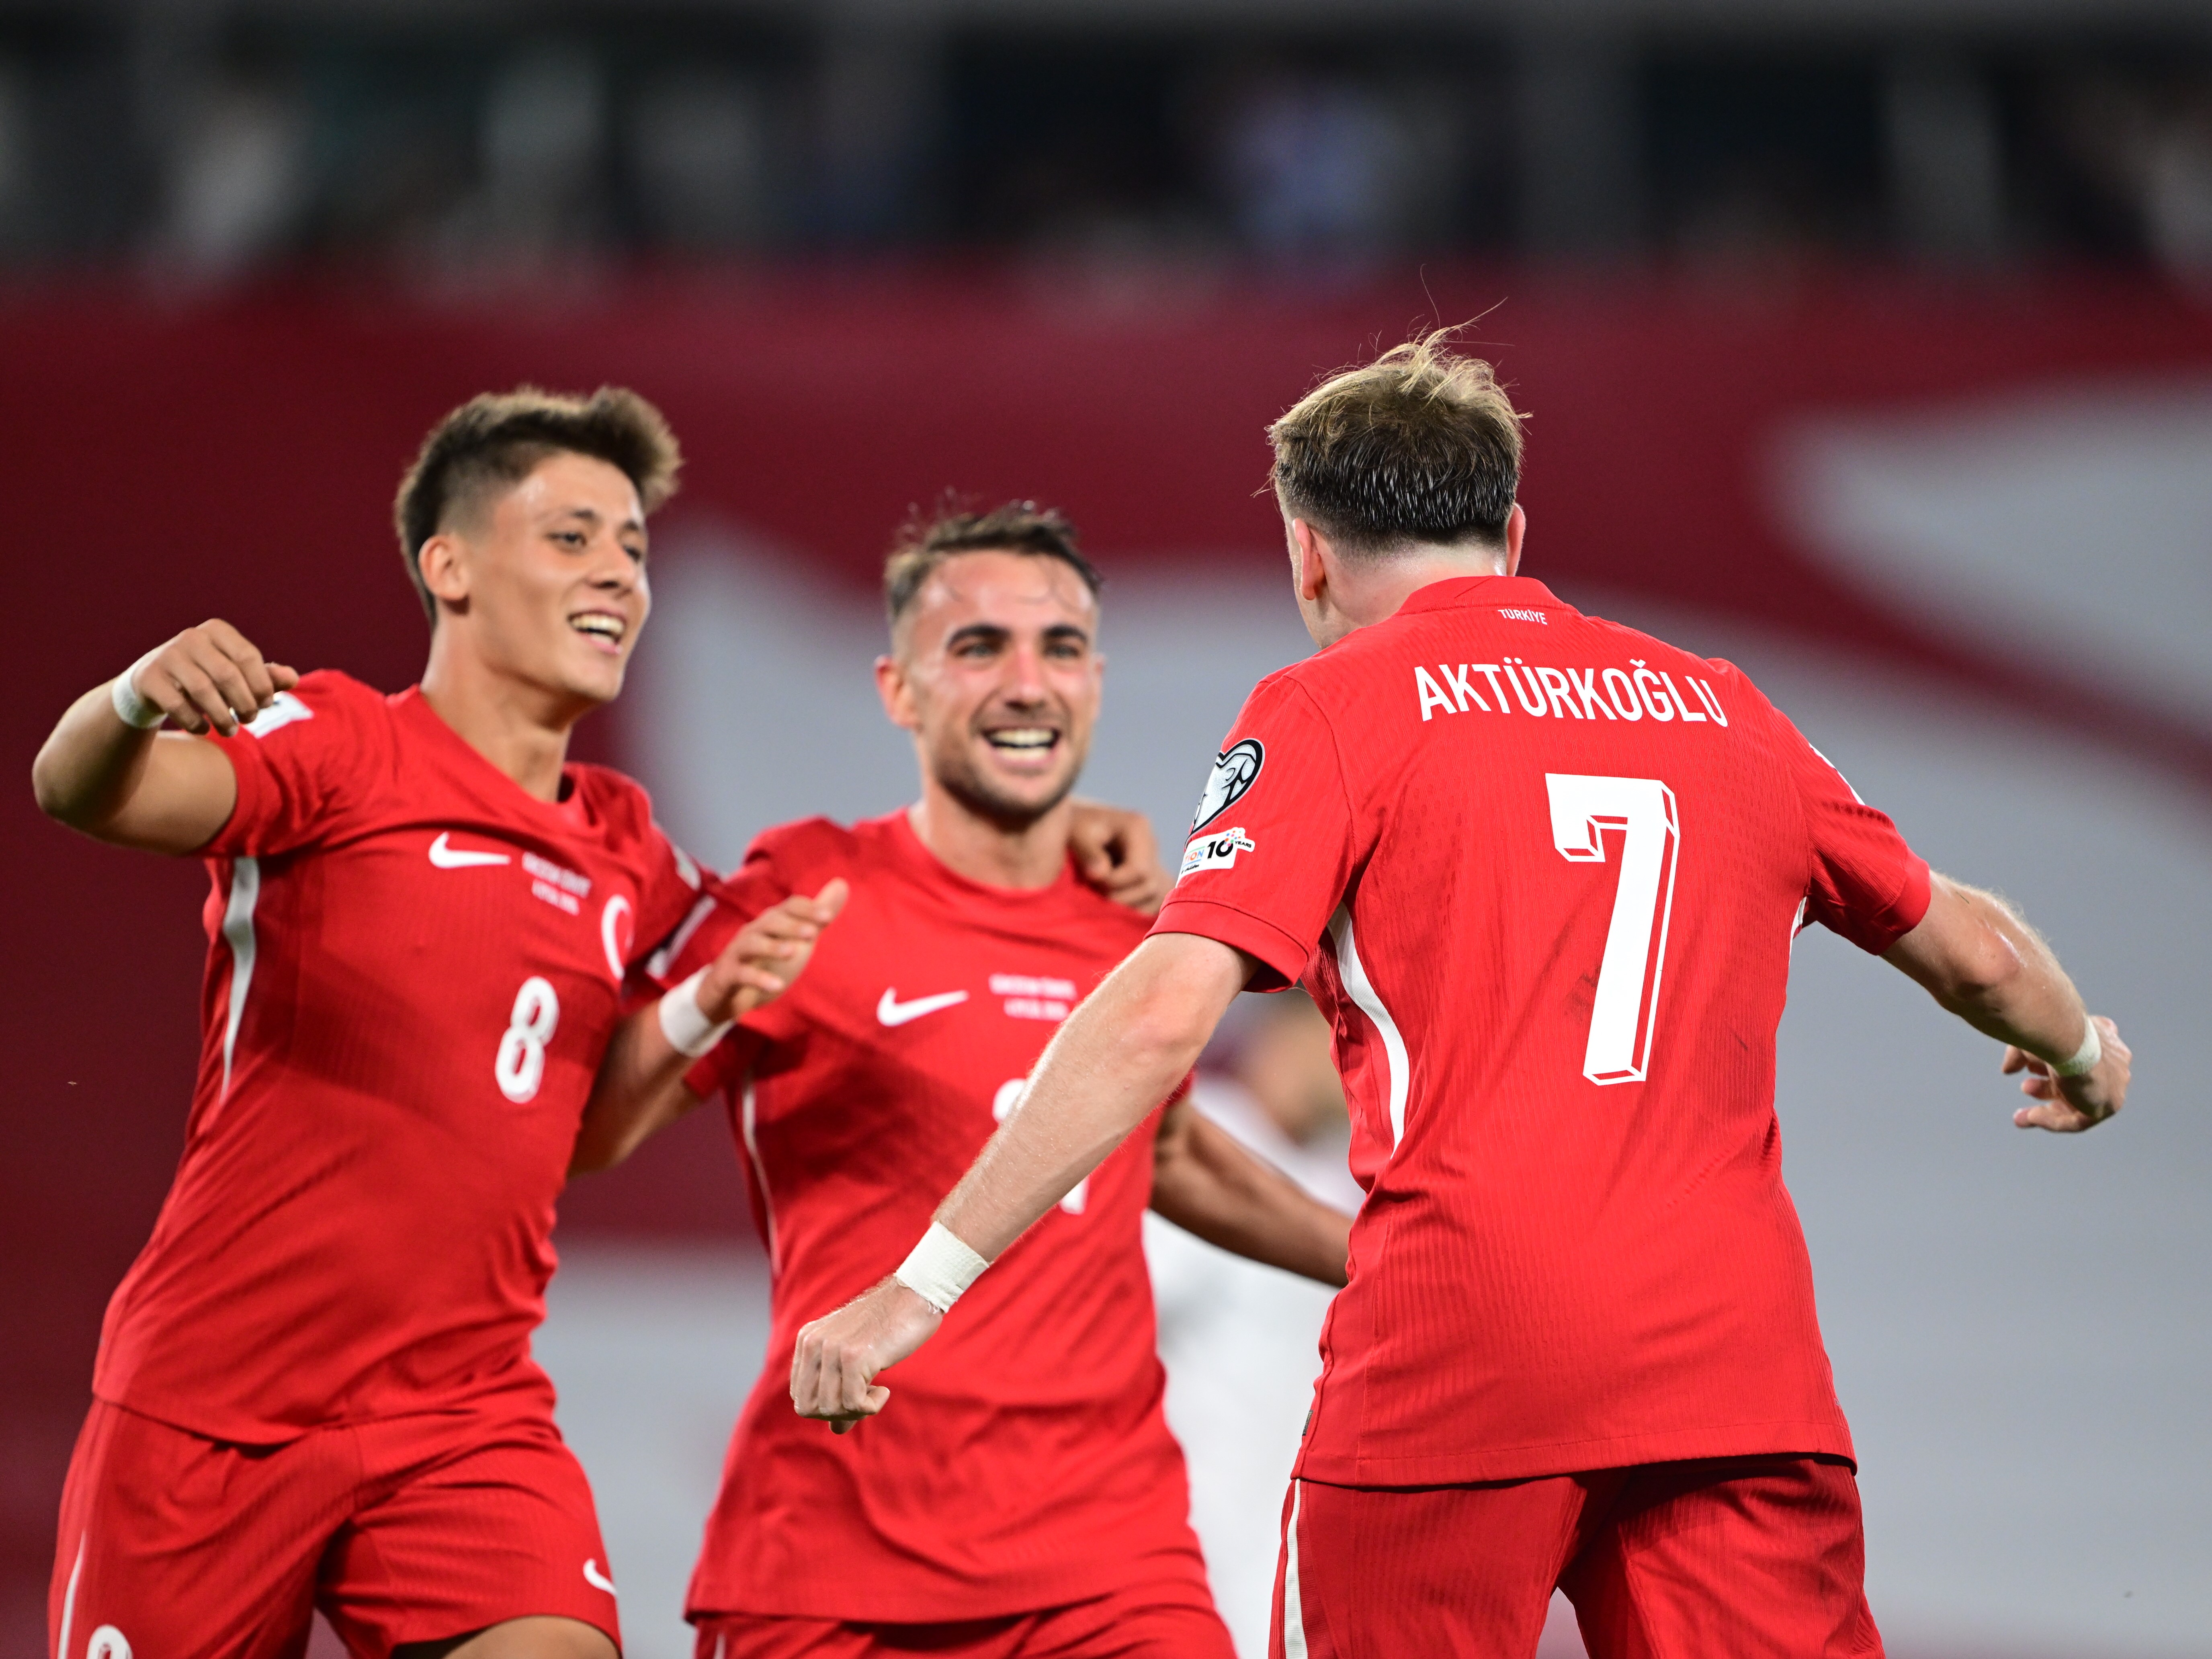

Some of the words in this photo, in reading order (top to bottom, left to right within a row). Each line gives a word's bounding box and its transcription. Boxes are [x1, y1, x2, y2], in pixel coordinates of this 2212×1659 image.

[1497, 608, 1548, 625] TÜRKİYE
[1414, 657, 1728, 727] AKTÜRKOĞLU
[1207, 839, 1234, 859] 10
[1545, 773, 1680, 1086] 7
[495, 977, 559, 1103] 8
